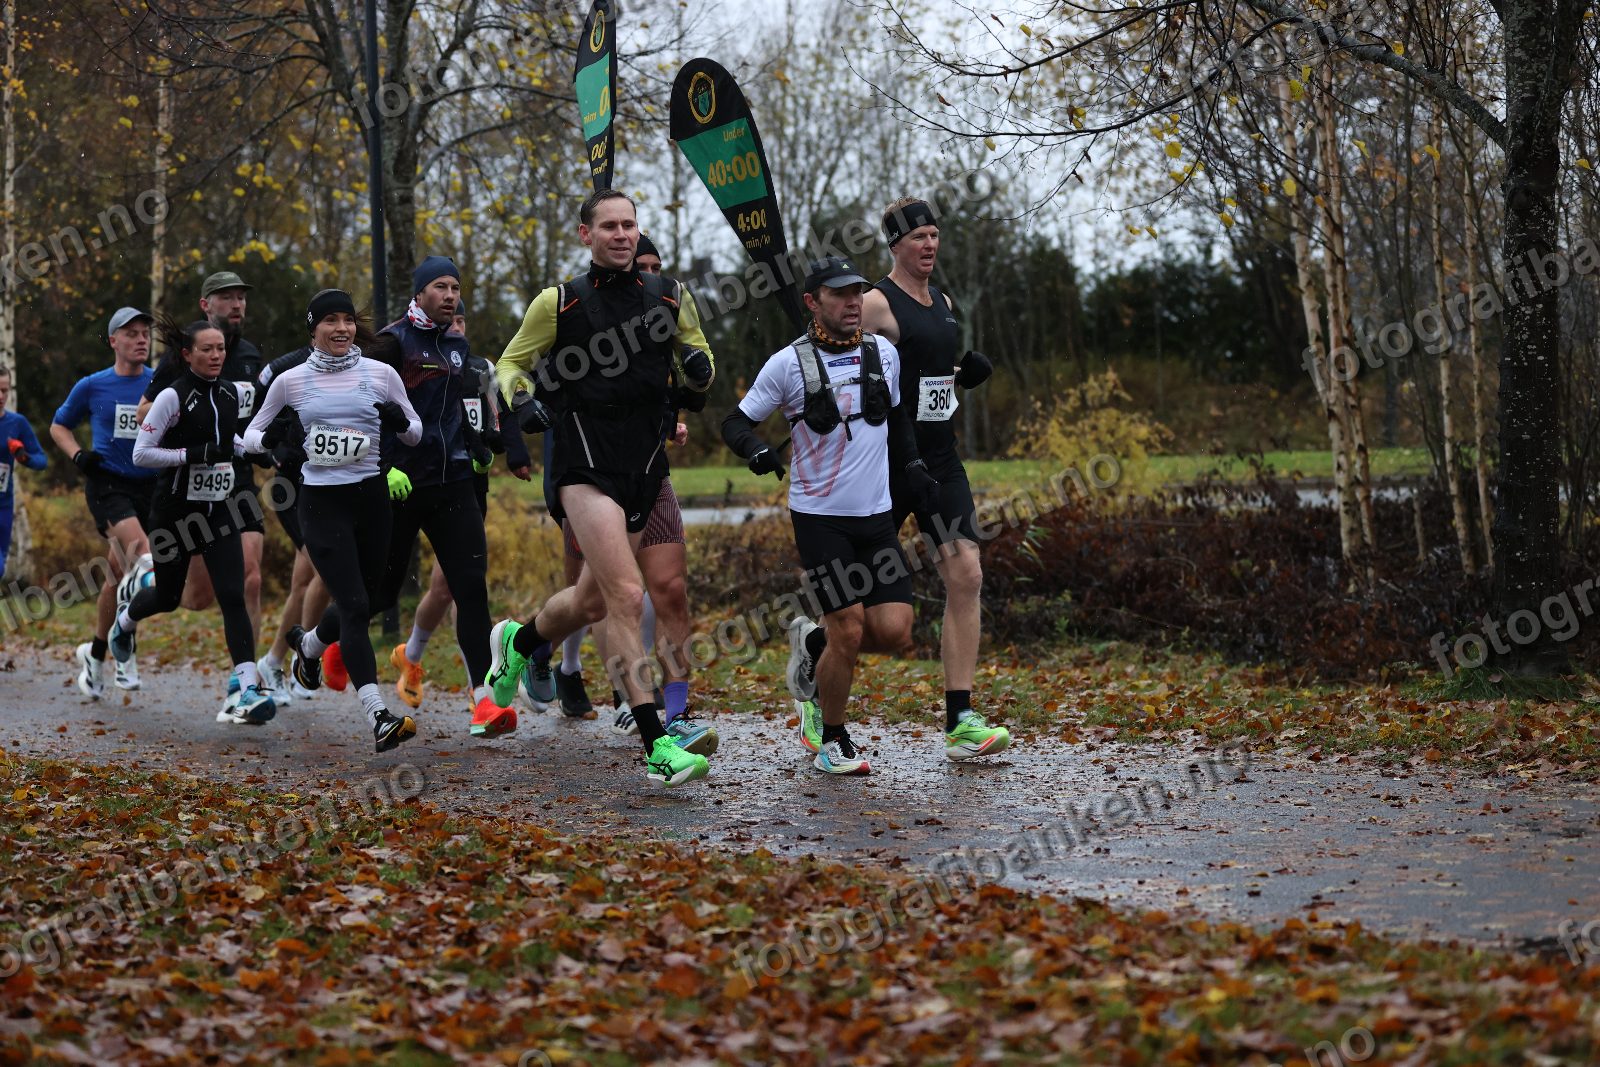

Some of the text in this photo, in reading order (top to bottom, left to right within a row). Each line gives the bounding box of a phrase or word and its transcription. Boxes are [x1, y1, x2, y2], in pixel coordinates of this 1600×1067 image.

[722, 127, 745, 142] Under
[707, 151, 760, 188] 40:00
[737, 208, 767, 233] 4:00
[928, 388, 951, 411] 360
[119, 413, 137, 430] 95
[314, 433, 365, 457] 9517
[193, 472, 231, 491] 9495
